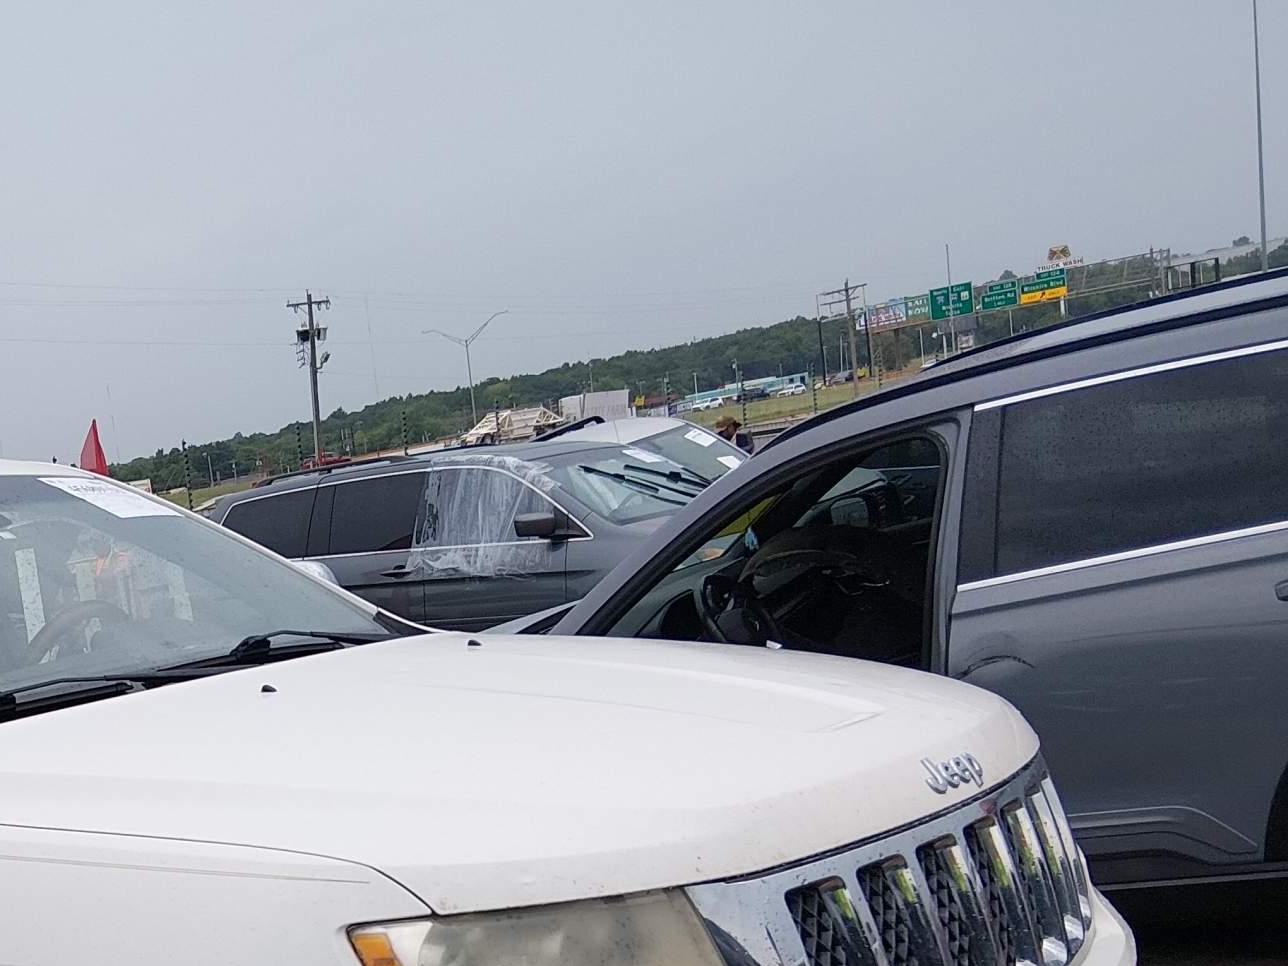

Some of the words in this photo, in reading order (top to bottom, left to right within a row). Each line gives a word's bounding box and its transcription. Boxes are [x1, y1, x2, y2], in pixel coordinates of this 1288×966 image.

[1037, 262, 1061, 271] TRUCK
[1063, 257, 1083, 267] WASH
[920, 752, 984, 795] Jeep
